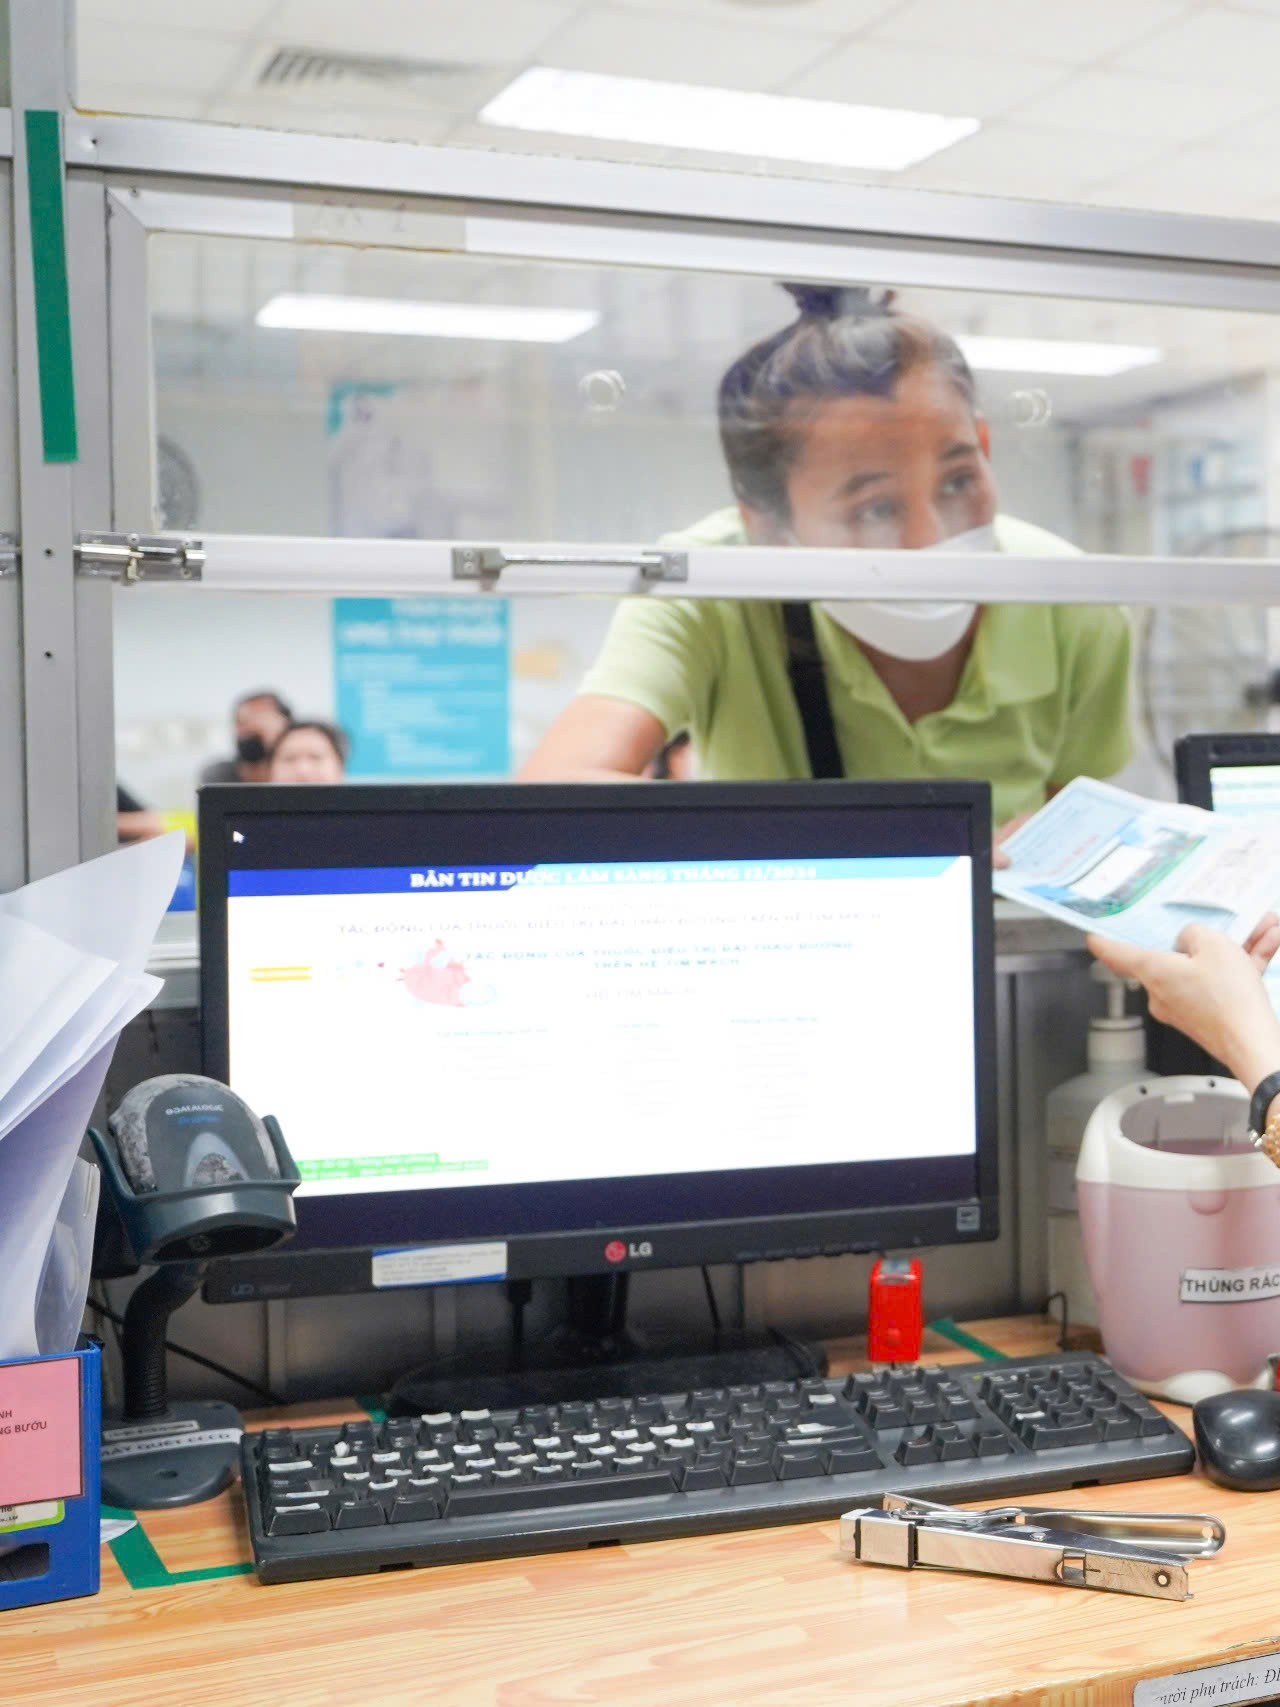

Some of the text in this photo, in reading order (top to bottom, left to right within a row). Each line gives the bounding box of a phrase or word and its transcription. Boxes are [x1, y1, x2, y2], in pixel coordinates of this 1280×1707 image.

[410, 869, 454, 888] BẢN
[457, 870, 496, 887] TIN
[629, 1241, 653, 1257] LG
[1183, 1275, 1245, 1293] THÙNG
[1249, 1272, 1280, 1290] RÁC
[1190, 1682, 1216, 1704] phụ
[1220, 1672, 1259, 1692] trách:
